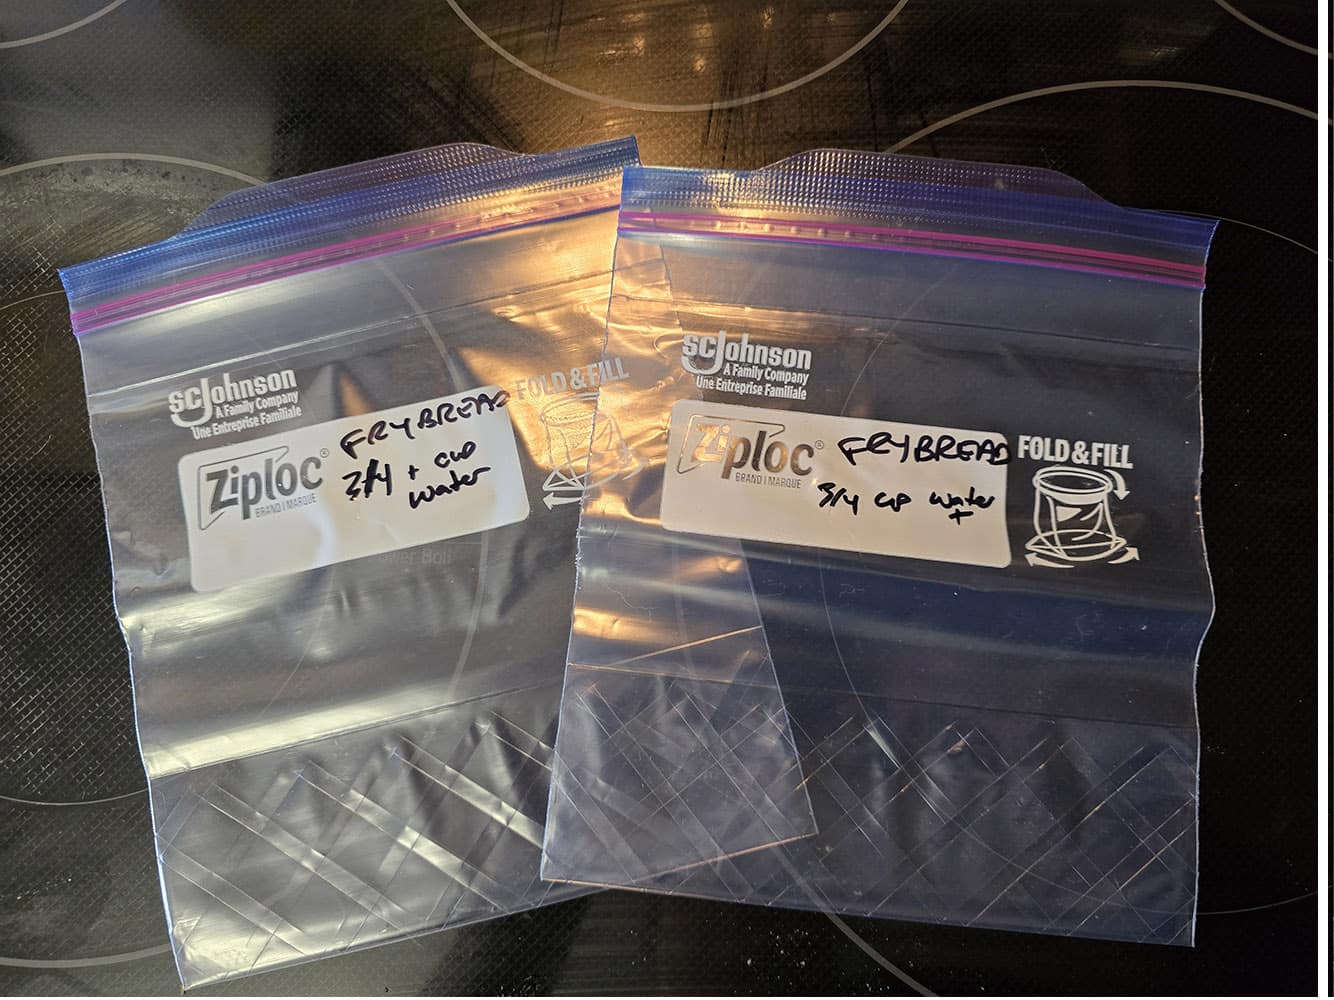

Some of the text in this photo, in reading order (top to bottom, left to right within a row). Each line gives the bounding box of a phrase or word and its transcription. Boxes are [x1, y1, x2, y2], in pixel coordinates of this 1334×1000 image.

[723, 363, 809, 386] A Family Company
[696, 375, 807, 400] Une Entreprise Familiale
[215, 391, 299, 419] A Family Company
[191, 405, 302, 440] Une Entreprise Familiale
[736, 472, 762, 485] BRAND
[767, 475, 801, 489] MARQUE
